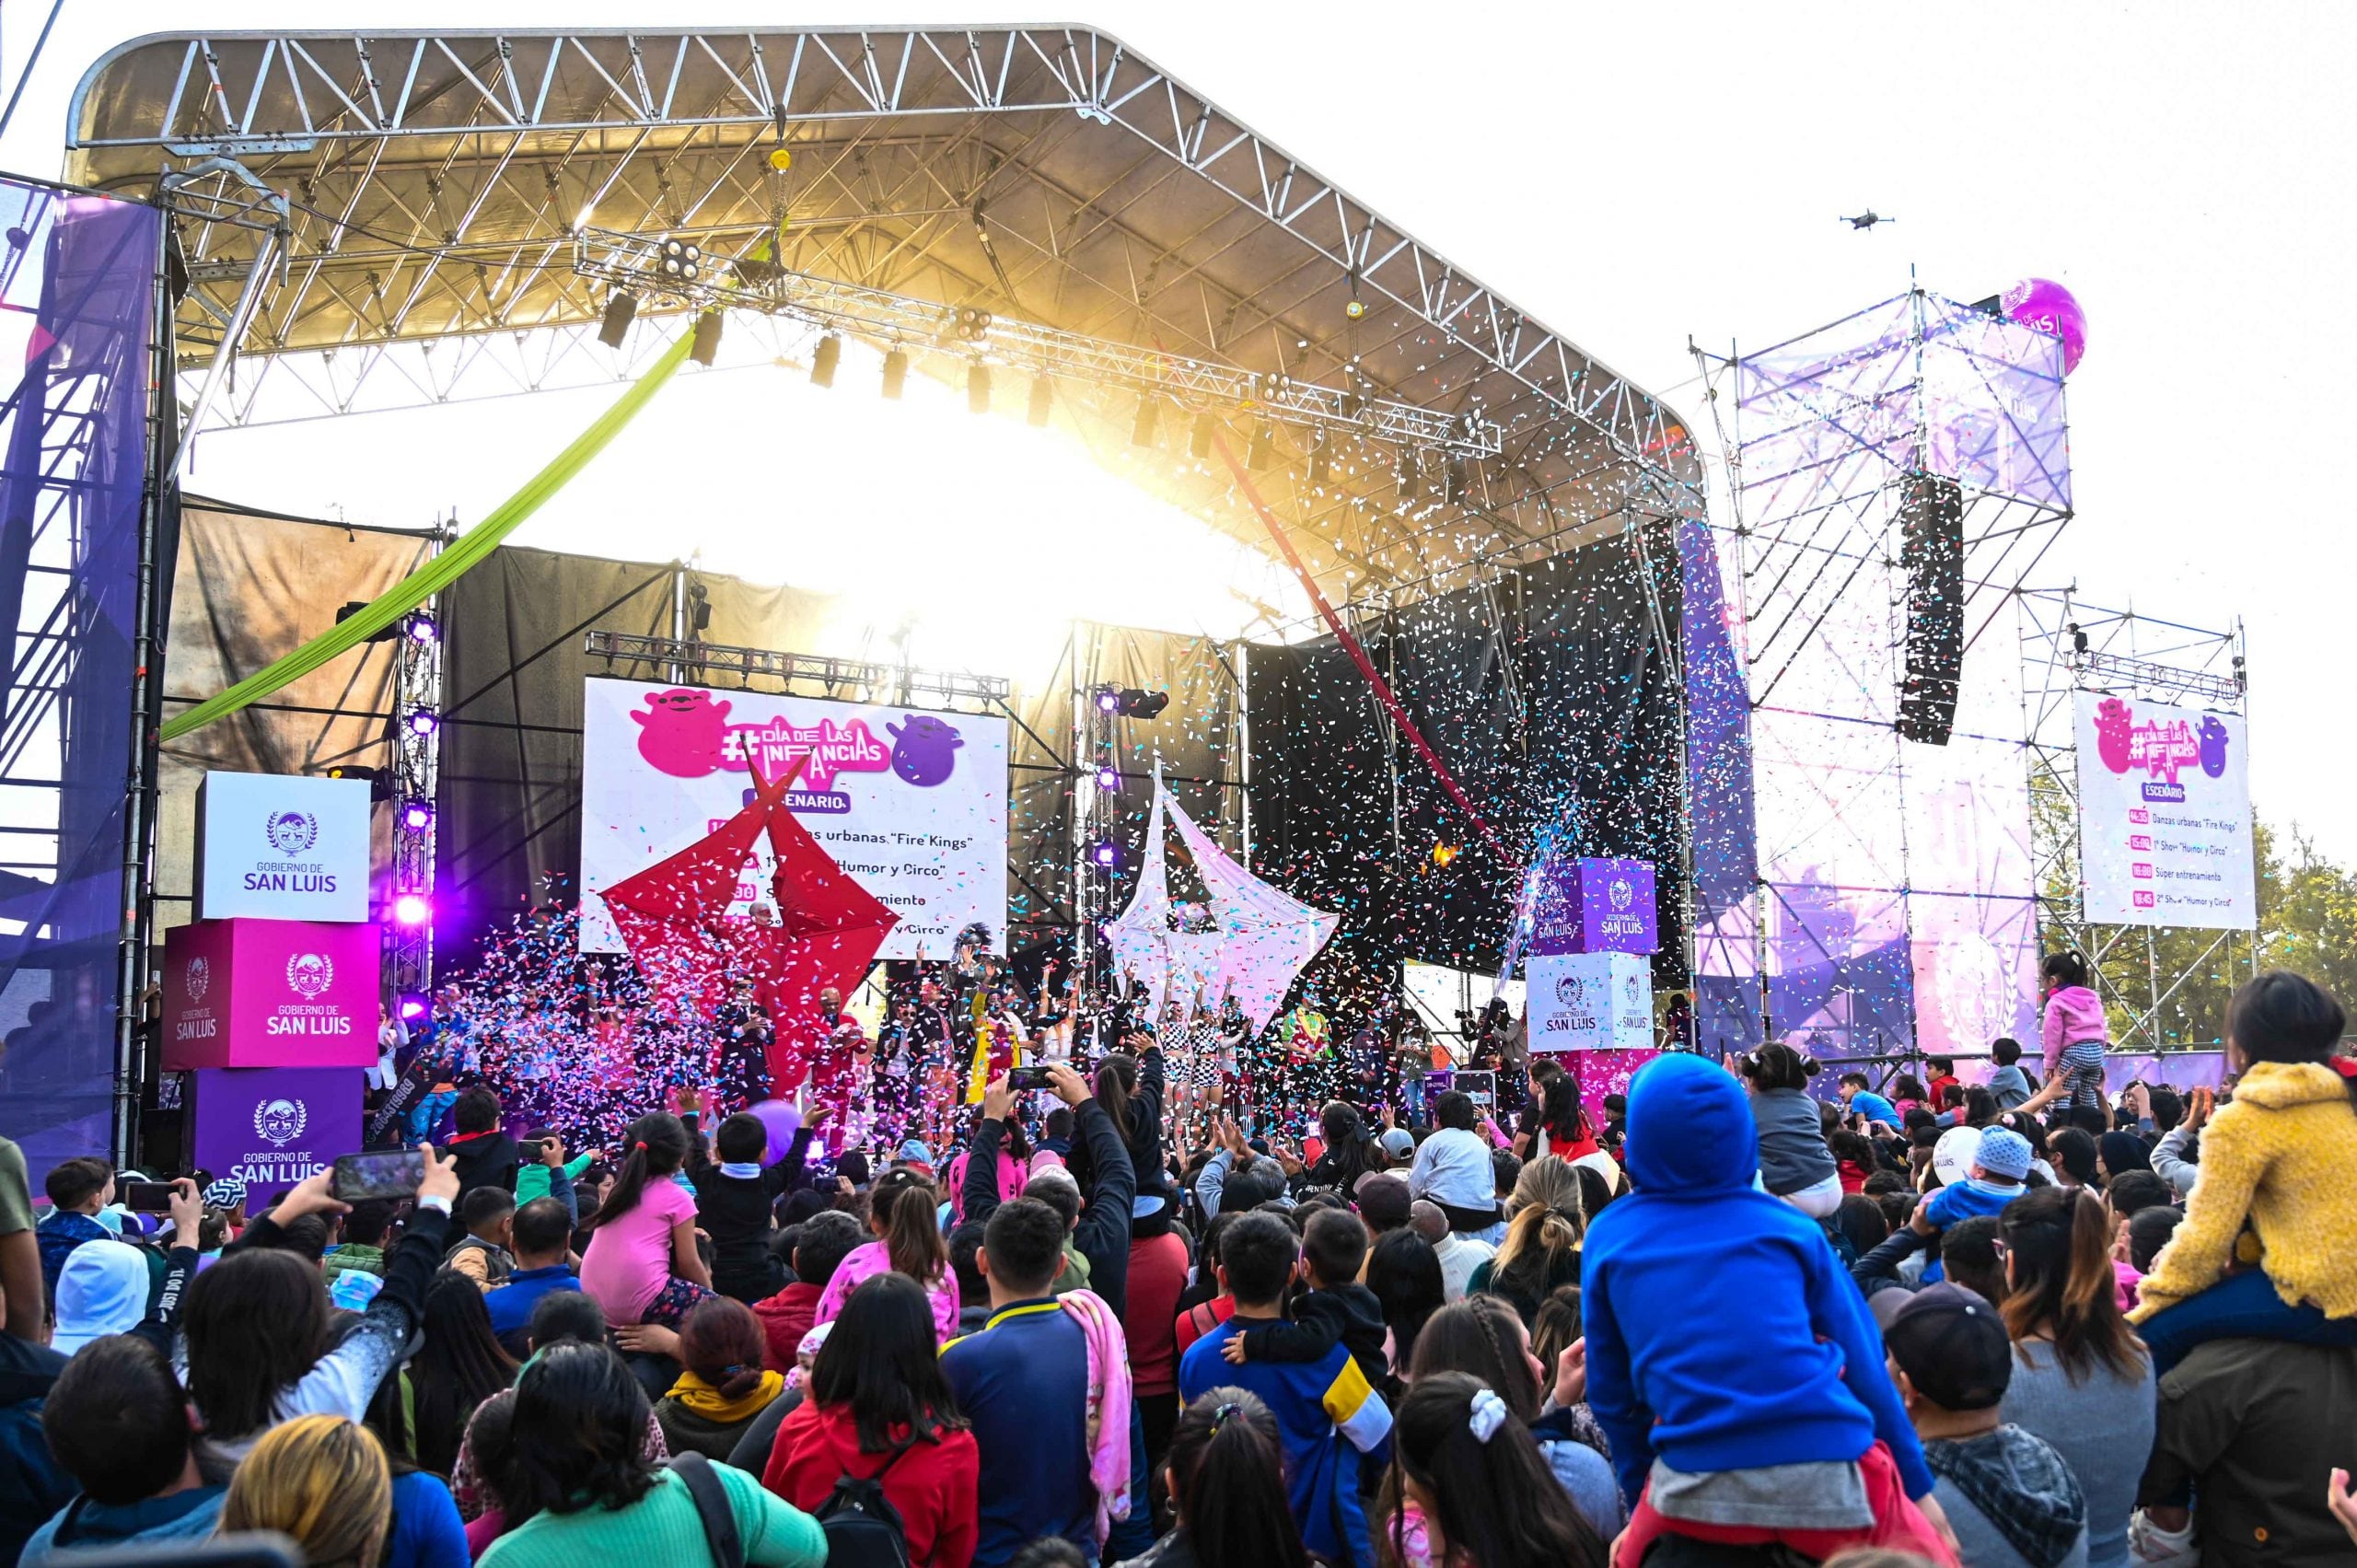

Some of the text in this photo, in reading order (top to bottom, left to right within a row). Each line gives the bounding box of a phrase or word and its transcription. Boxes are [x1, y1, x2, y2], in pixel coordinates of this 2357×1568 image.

[2023, 312, 2036, 324] DE
[794, 730, 819, 742] DE
[825, 722, 853, 743] LAS
[2169, 723, 2184, 742] LAS
[762, 727, 882, 780] INFANCIAS
[2145, 784, 2183, 799] ESCENARIO
[754, 791, 844, 809] ENARIO
[2153, 813, 2176, 825] Danzas
[2177, 816, 2202, 828] urbanas
[826, 830, 887, 844] urbanas
[2205, 846, 2209, 857] y
[256, 862, 324, 874] GOBIERNO DE
[890, 865, 900, 877] y
[2176, 869, 2222, 882] entrenamiento
[243, 873, 337, 893] SAN LUIS
[2210, 899, 2213, 909] y
[1538, 923, 1573, 939] SAN LUIS
[1601, 921, 1643, 935] SAN LUIS
[181, 1007, 211, 1021] GOBIERNO DE
[278, 1005, 339, 1015] GOBIERNO DE
[176, 1018, 216, 1040] SAN LUIS
[266, 1016, 352, 1035] SAN LUIS
[1546, 1016, 1596, 1031] SAN LUIS
[1622, 1016, 1646, 1029] SAN LUIS
[370, 1077, 416, 1135] 2664319989
[243, 1152, 312, 1163] GOBIERNO DE
[230, 1163, 325, 1183] SAN LUIS
[165, 1278, 183, 1292] DO
[158, 1292, 180, 1311] JUST
